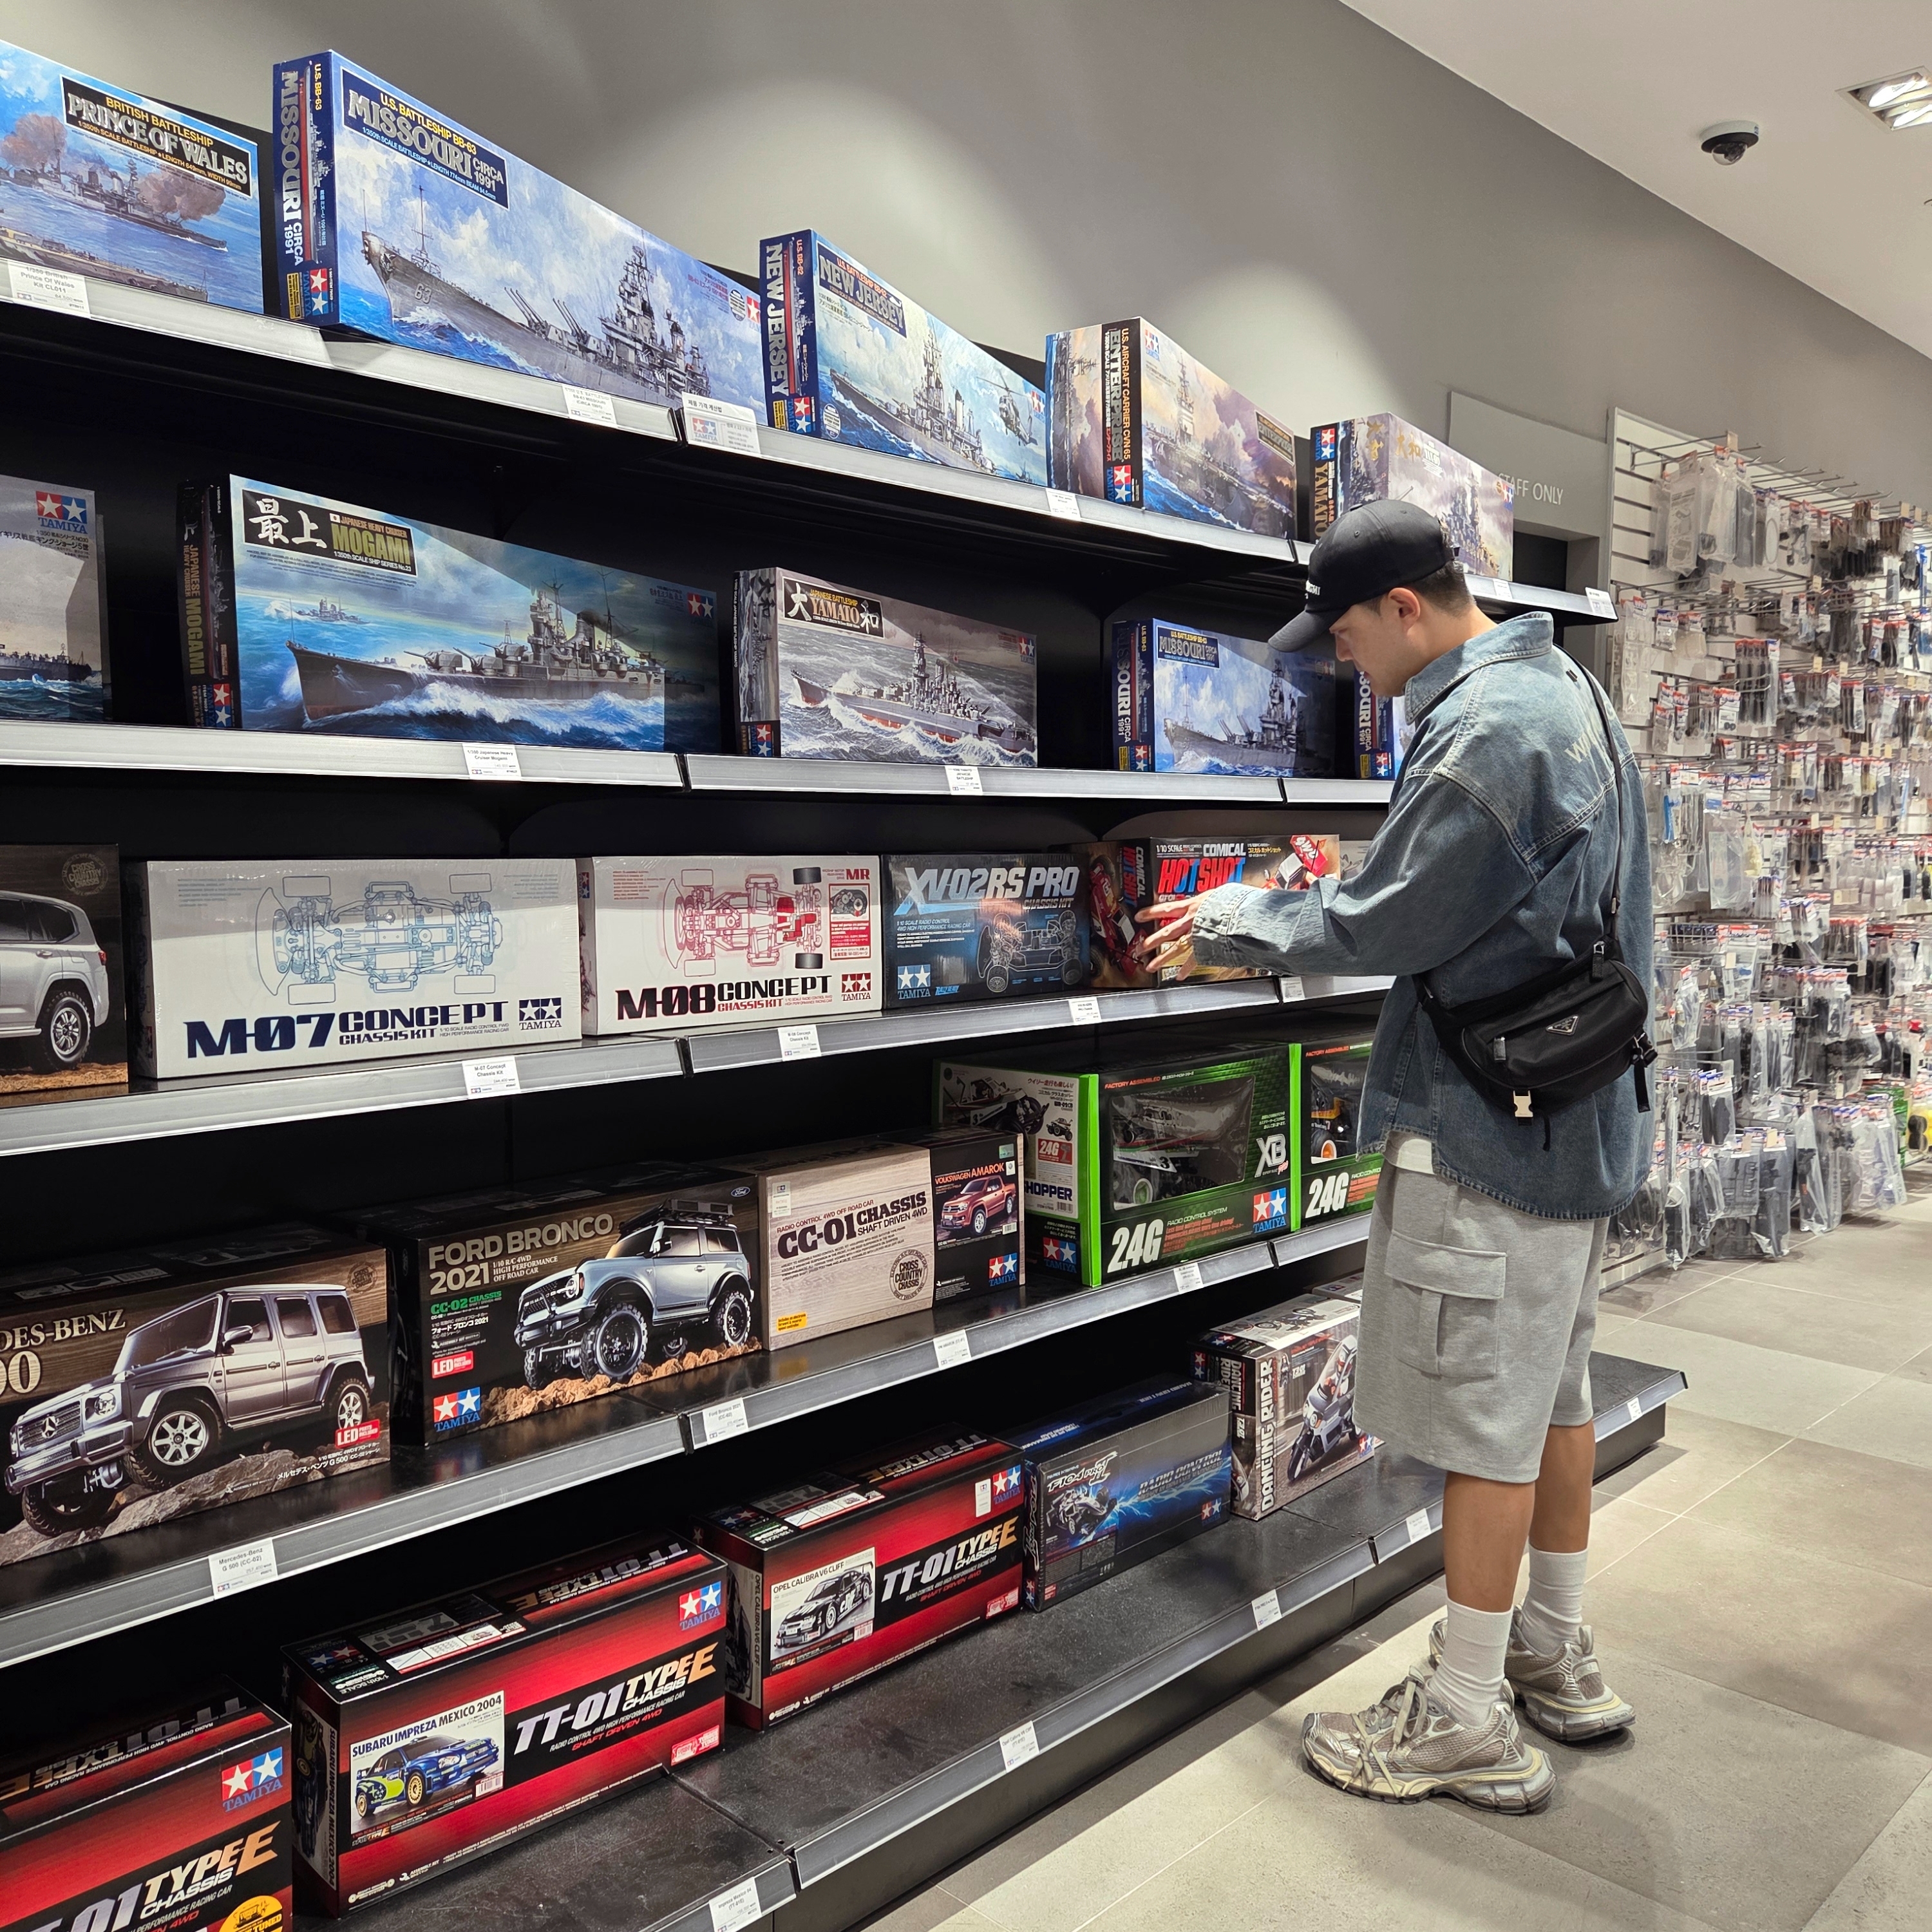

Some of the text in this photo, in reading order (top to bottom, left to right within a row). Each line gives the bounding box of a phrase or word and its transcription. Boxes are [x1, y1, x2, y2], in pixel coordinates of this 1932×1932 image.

[106, 97, 214, 147] BRITISH BATTLESHIP
[348, 89, 473, 178] MISSOURI
[68, 93, 149, 146] PRINCE
[149, 127, 180, 155] OF
[180, 137, 247, 184] WALES
[281, 71, 301, 223] MISSOURI
[473, 157, 504, 184] CIRCA
[474, 171, 496, 192] 1991
[284, 223, 294, 254] 1991
[292, 222, 303, 266] CIRCA
[21, 272, 43, 281] Prince
[55, 279, 75, 289] Wales
[414, 282, 432, 304] 63
[819, 254, 855, 296] NEW
[856, 280, 904, 329] JERSEY
[766, 242, 789, 397] NEW JERSEY
[1110, 329, 1123, 462] ENTERPRISE
[694, 431, 718, 442] TAMIYA
[1314, 463, 1329, 537] YAMATO
[1533, 482, 1564, 506] ONLY
[38, 517, 88, 535] TAMIYA
[249, 498, 327, 549] 最上
[331, 523, 411, 565] MOGAMI
[189, 544, 200, 597] JAPANESE
[787, 582, 812, 621] 大
[809, 589, 858, 607] JAPANESE BATTLESHIP
[810, 596, 860, 624] YAMATO
[860, 600, 880, 634] 和
[185, 598, 205, 675] MOGAMI
[1159, 636, 1206, 660] MISSOURI
[1203, 843, 1246, 857] COMICAL
[846, 868, 870, 880] MR
[1135, 846, 1146, 898] COMICAL
[1023, 898, 1074, 910] CHASSIS KIT
[717, 975, 832, 1001] CONCEPT
[841, 992, 871, 1001] TAMIYA
[898, 989, 931, 999] TAMIYA
[339, 1001, 509, 1033] CONCEPT
[717, 998, 783, 1012] CHASSIS KIT
[339, 1028, 437, 1045] CHASSIS KIT
[518, 1019, 562, 1030] TAMIYA
[1325, 1045, 1349, 1054] ASSEMBLED
[1104, 1076, 1160, 1089] FACTORY ASSEMBLED
[935, 1162, 1005, 1186] VOLKSWAGEN AMAROK
[777, 1199, 874, 1233] RADIO CONTROL 4WD OFF ROAD CAR
[857, 1191, 927, 1226] CHASSIS
[857, 1207, 928, 1236] SHAFT DRIVEN 4WD
[1167, 1207, 1228, 1226] RADIO CONTROL SYSTEM
[777, 1213, 857, 1259] CC-01
[1253, 1217, 1286, 1234] TAMIYA
[428, 1213, 614, 1269] FORD BRONCO
[493, 1256, 558, 1275] HIGH PERFORMANCE
[506, 1258, 516, 1267] R/C
[516, 1255, 532, 1265] 4WD
[899, 1260, 918, 1273] CROSS
[1044, 1258, 1077, 1274] TAMIYA
[430, 1265, 489, 1296] 2021
[493, 1266, 540, 1283] OFF ROAD CAR
[895, 1268, 922, 1283] COUNTRY
[898, 1279, 920, 1291] CHASSIS
[989, 1273, 1017, 1287] TAMIYA
[430, 1291, 502, 1315] CC-02 CHASSIS
[431, 1316, 489, 1334] フォード ブロンコ 2021
[433, 1358, 454, 1376] LED
[1230, 1359, 1242, 1411] DANCING
[435, 1411, 481, 1432] TAMIYA
[1260, 1358, 1276, 1513] DANCING RIDER
[994, 1486, 1021, 1505] TAMIYA
[219, 1548, 263, 1565] Mercedes-Benz
[240, 1555, 262, 1567] (CC-02)
[954, 1543, 998, 1571] CHASSIS
[773, 1561, 844, 1594] OPEL CALIBRA V6 CLIFF
[881, 1544, 957, 1603] TT-01
[920, 1569, 982, 1602] SHAFT DRIVEN 4WD
[679, 1607, 721, 1631] TAMIYA
[755, 1633, 761, 1643] V6
[622, 1676, 687, 1712] CHASSIS
[352, 1694, 503, 1758] SUBARU IMPREZA MEXICO 2004
[514, 1681, 626, 1756] TT-01
[549, 1690, 685, 1752] RADIO CONTROL 4WD HIGH PERFORMANCE RACING CAR
[44, 1722, 214, 1790] RADIO CONTROL 4WD HIGH PERFORMANCE RACING CAR
[222, 1777, 283, 1814] TAMIYA
[140, 1867, 234, 1920] CHASSIS
